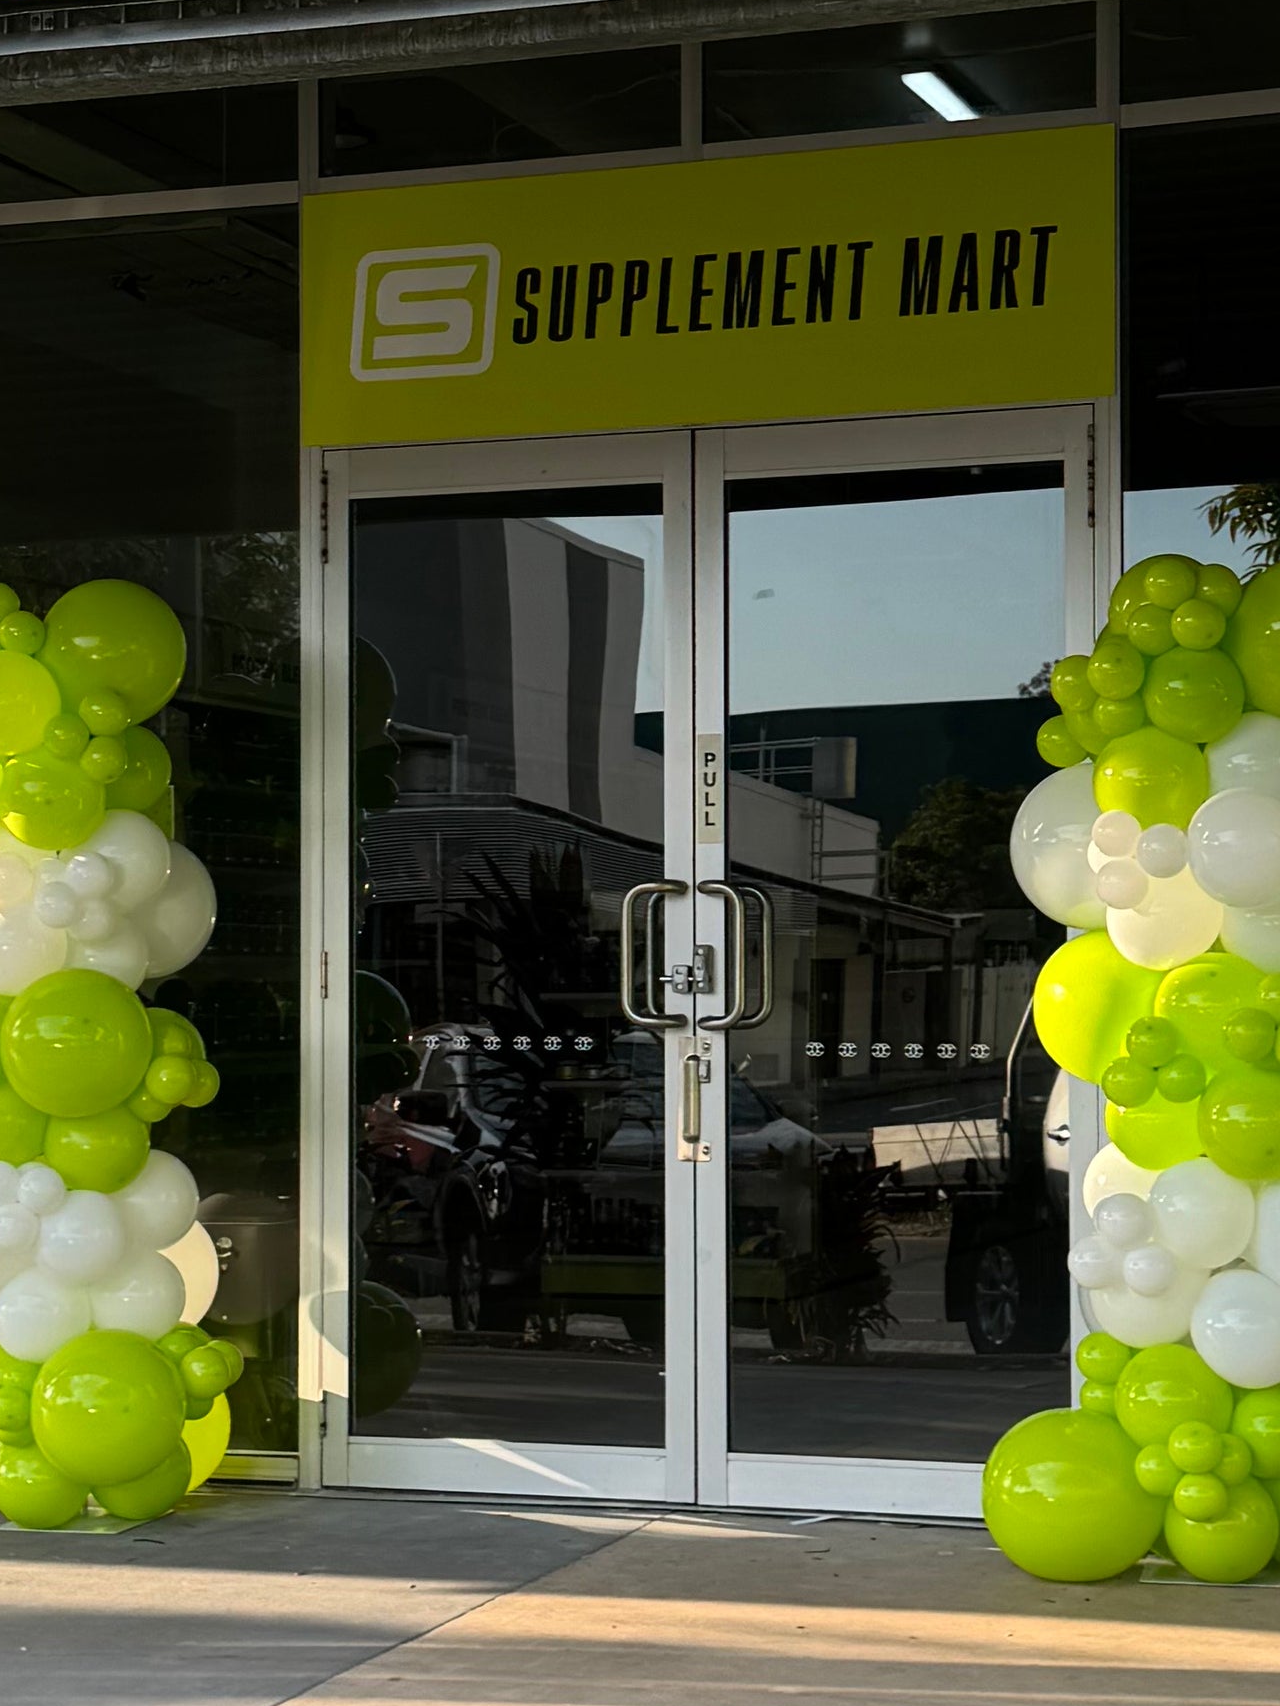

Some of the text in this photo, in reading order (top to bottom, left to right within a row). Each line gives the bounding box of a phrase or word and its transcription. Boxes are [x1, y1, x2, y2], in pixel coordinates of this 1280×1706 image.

[512, 225, 1059, 345] SUPPLEMENT MART
[703, 751, 717, 827] PULL
